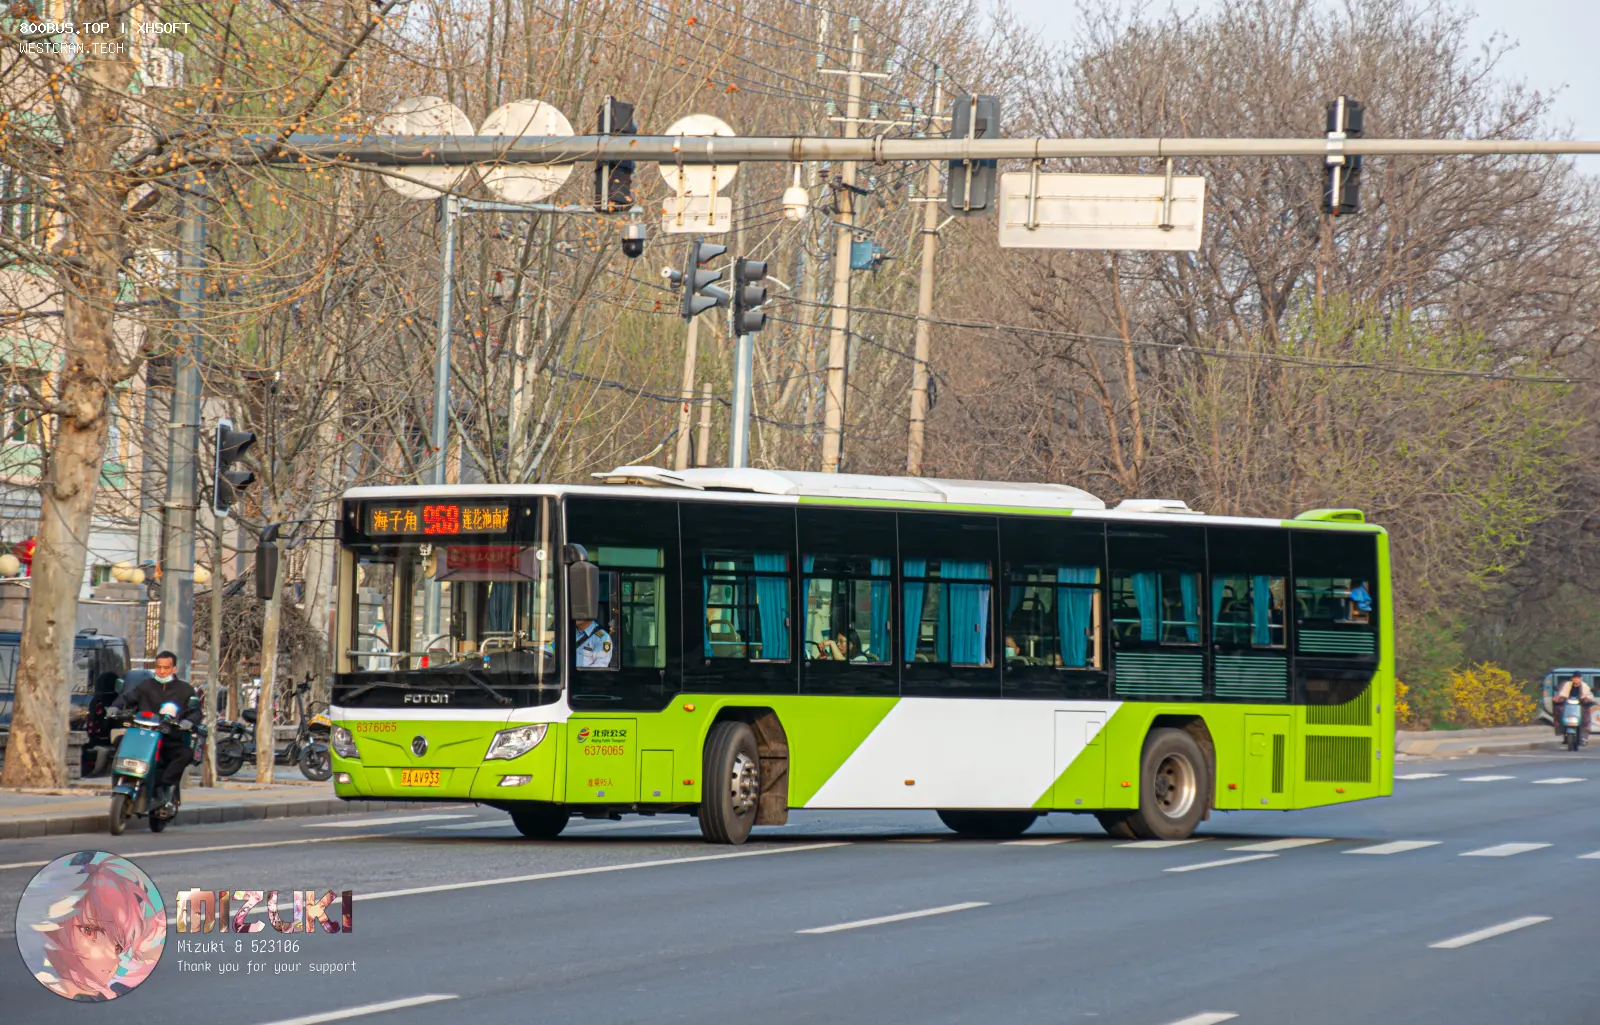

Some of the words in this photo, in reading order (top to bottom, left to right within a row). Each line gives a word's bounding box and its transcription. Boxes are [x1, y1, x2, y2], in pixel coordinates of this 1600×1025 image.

[373, 509, 417, 532] 海子角
[404, 694, 449, 704] FOTON
[356, 722, 397, 733] 6376065
[591, 729, 627, 738] 北京公交
[584, 745, 625, 756] 6376065
